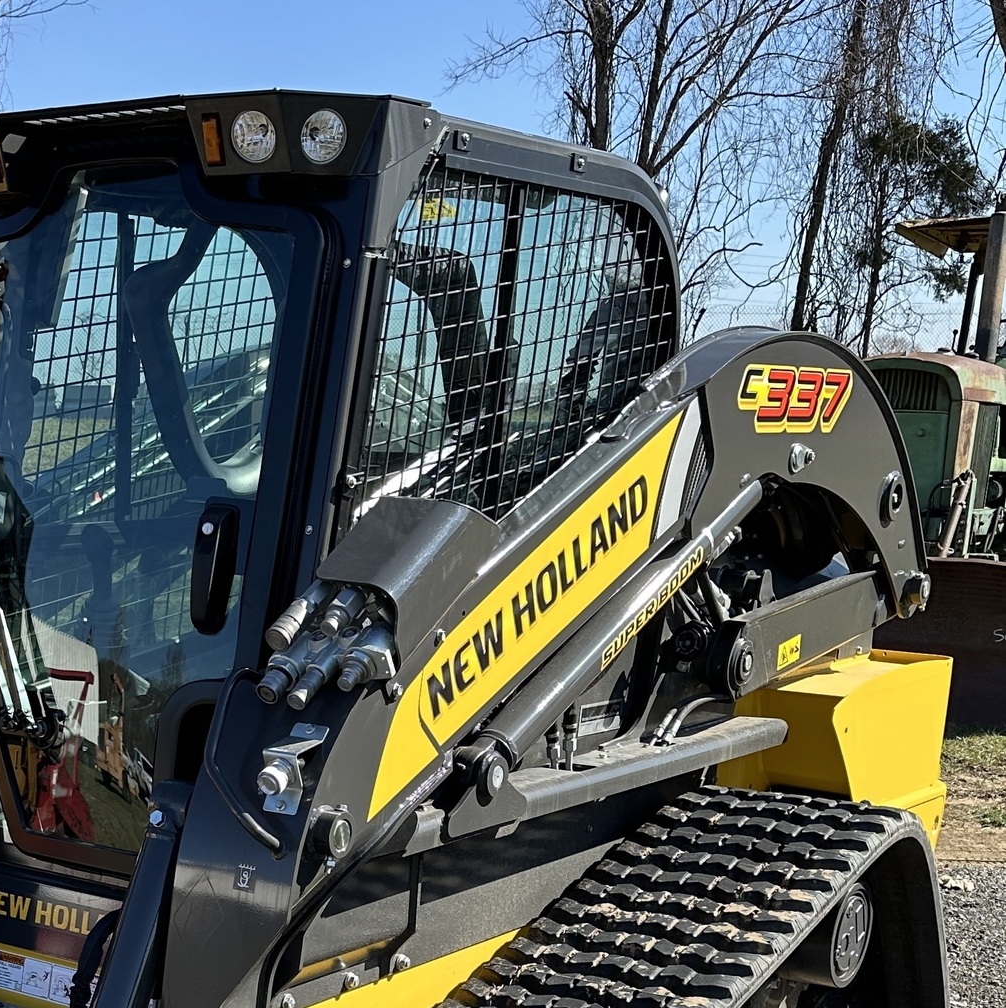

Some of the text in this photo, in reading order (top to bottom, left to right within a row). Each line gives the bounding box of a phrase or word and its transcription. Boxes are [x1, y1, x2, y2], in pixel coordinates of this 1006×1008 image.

[737, 364, 854, 433] C337
[427, 475, 649, 721] NEW HOLLAND
[601, 598, 657, 668] SUPER
[657, 546, 704, 608] BOOM
[34, 900, 105, 935] HOLL
